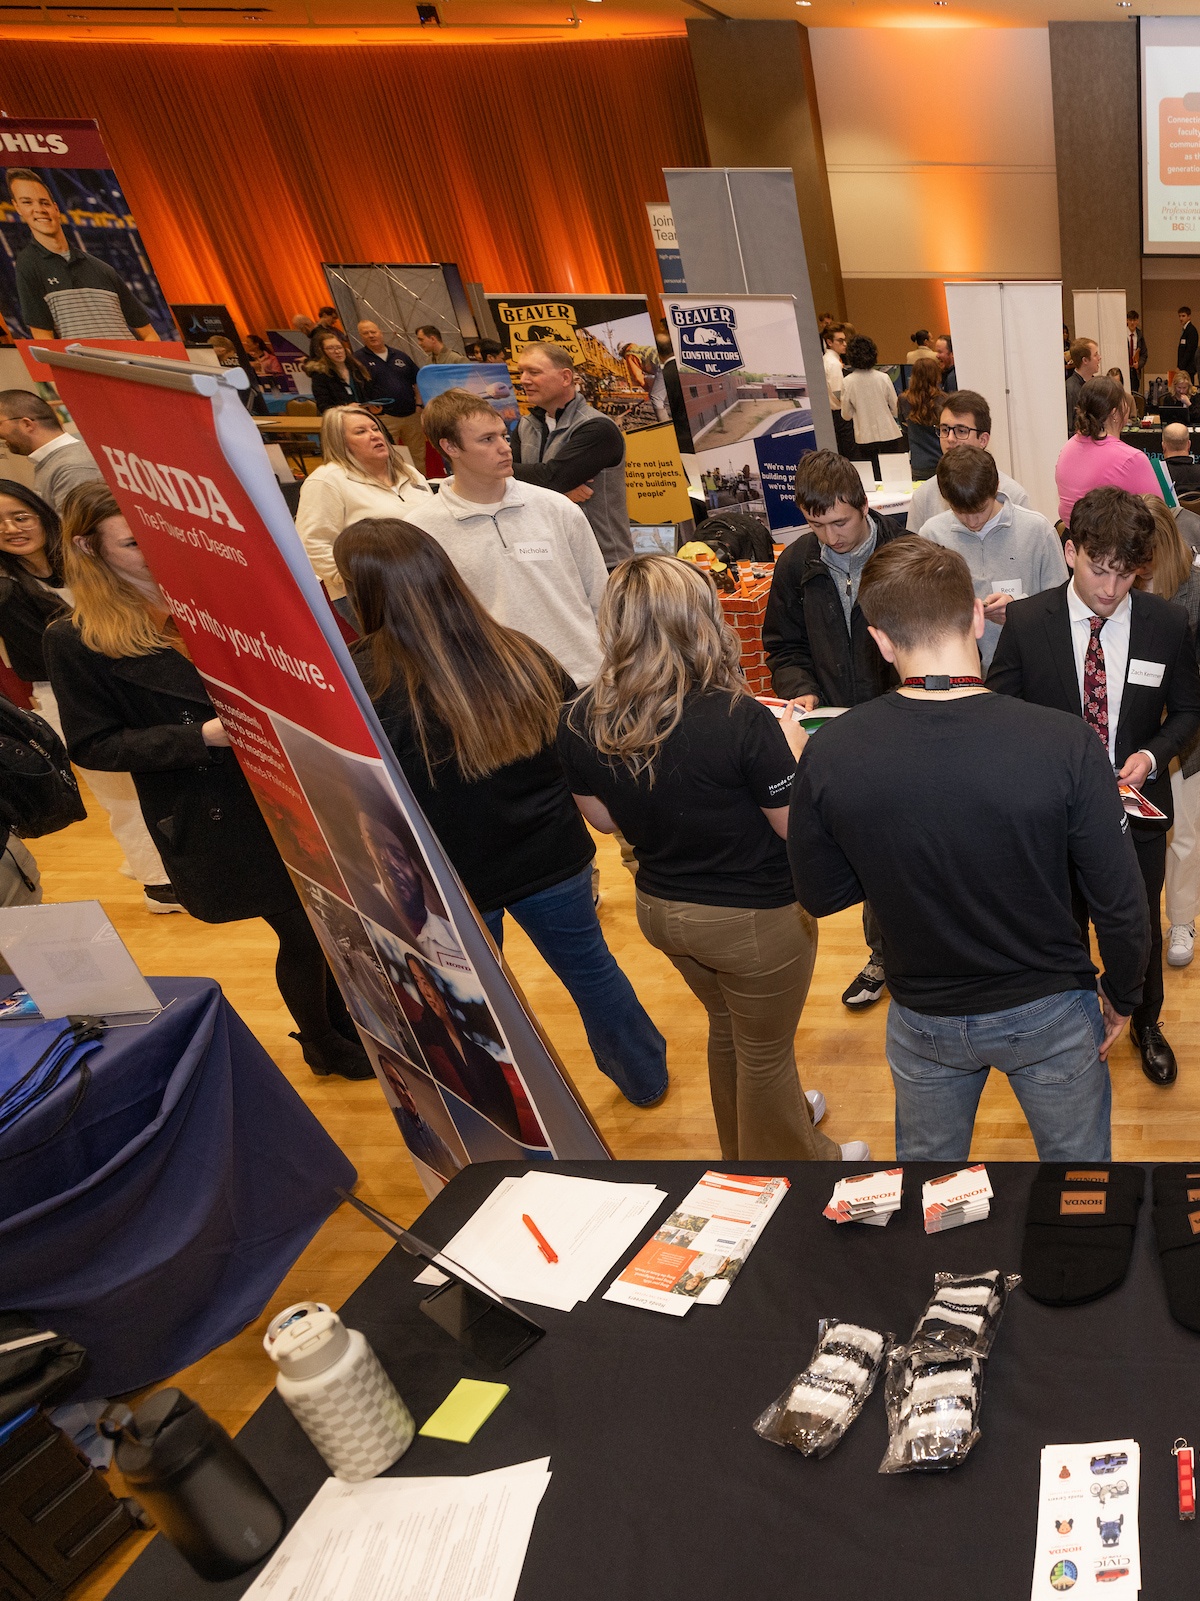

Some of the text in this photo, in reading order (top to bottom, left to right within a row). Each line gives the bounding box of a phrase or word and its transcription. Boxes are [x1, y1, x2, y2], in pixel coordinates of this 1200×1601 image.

[1184, 153, 1193, 161] as
[652, 215, 674, 227] Join
[503, 305, 570, 322] BEAVER
[674, 308, 731, 325] BEAVER
[682, 350, 740, 361] CONSTRUCTORS
[704, 363, 721, 373] INC.
[657, 460, 674, 469] just
[761, 472, 788, 482] building
[101, 444, 246, 533] HONDA
[645, 480, 677, 488] building
[768, 483, 786, 491] we're
[134, 504, 248, 567] The Power of Dreams
[159, 583, 335, 693] Step into your future.
[1131, 668, 1144, 677] Zach
[950, 676, 985, 685] HONDA
[854, 1190, 897, 1203] HONDA
[947, 1186, 989, 1204] HONDA
[1064, 1198, 1104, 1207] HONDA
[1048, 1545, 1082, 1556] HONDA
[1094, 1557, 1131, 1569] CIVIC
